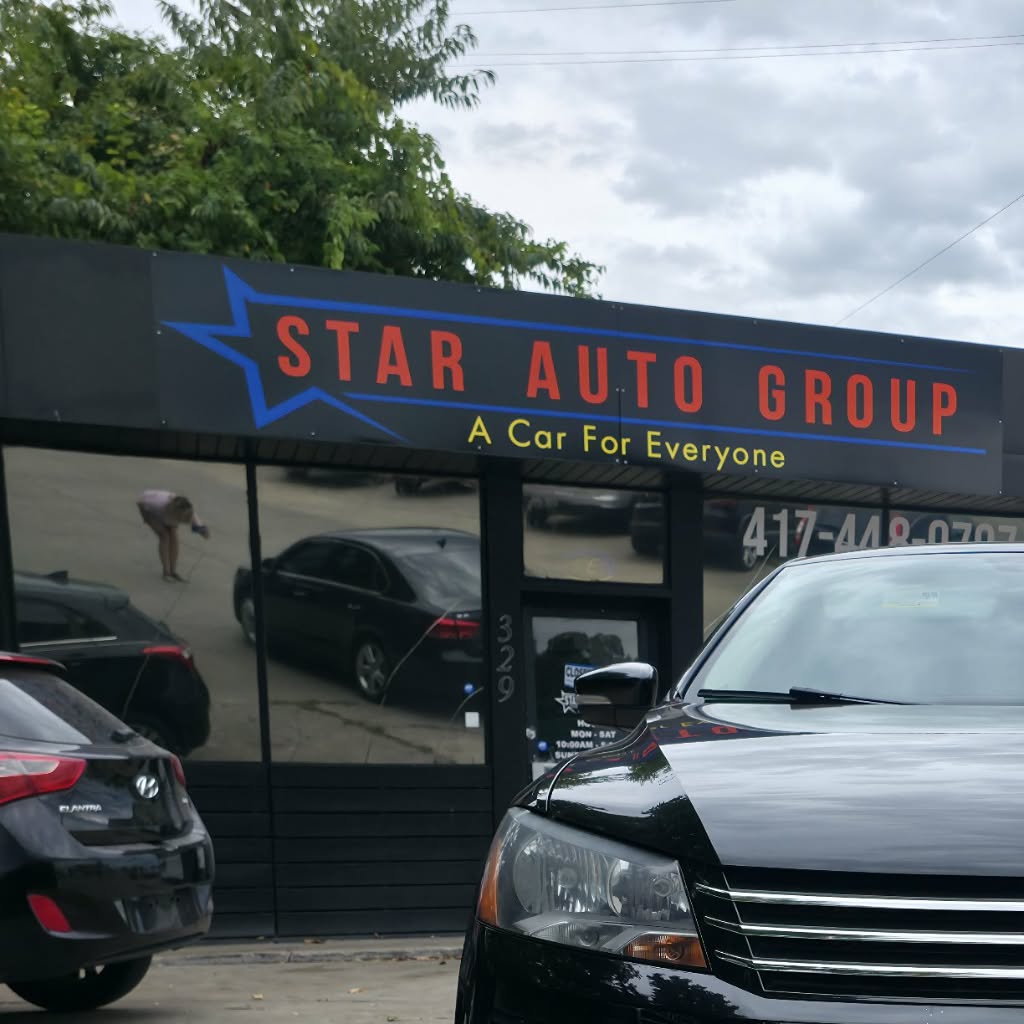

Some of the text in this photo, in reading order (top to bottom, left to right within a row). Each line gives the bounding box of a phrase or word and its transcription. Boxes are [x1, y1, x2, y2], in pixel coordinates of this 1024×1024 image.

[276, 314, 958, 436] STAR AUTO GROUP
[468, 415, 786, 472] A Car For Everyone
[495, 613, 516, 703] 329
[556, 740, 594, 749] 10:00AM
[570, 730, 593, 739] MON
[599, 730, 617, 739] SAT
[58, 803, 103, 814] ELANTRA
